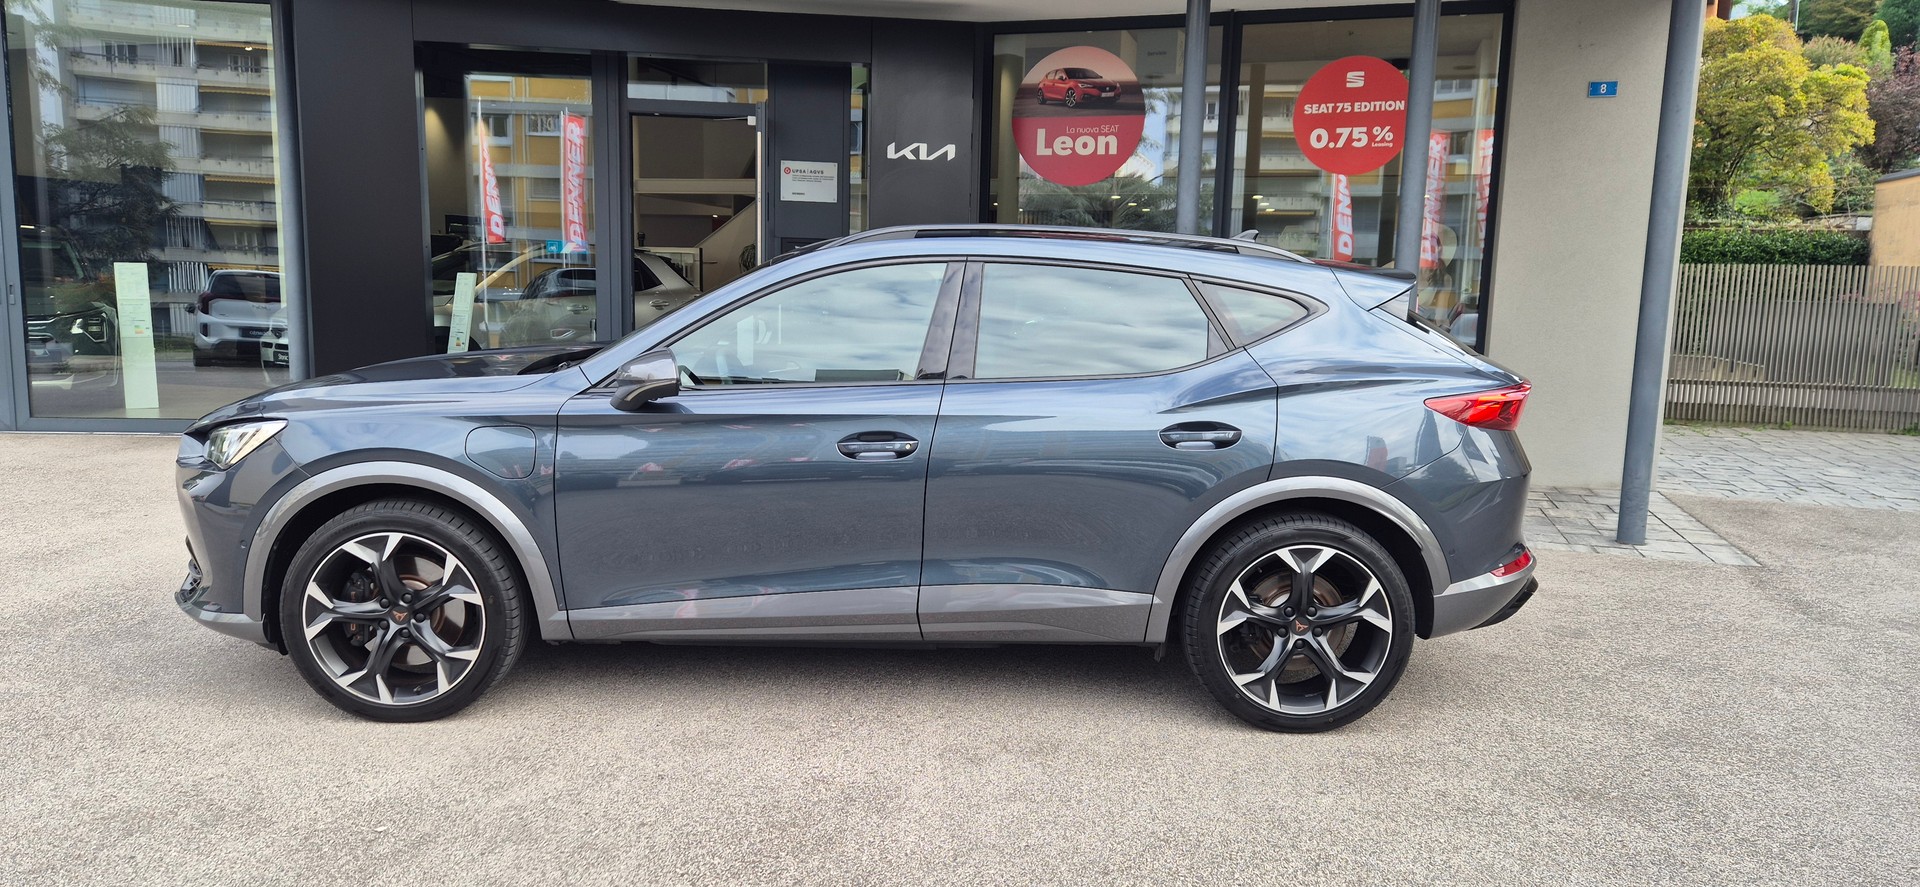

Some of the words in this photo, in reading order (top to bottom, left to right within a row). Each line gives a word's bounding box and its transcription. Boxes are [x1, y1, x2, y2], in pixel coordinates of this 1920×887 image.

[1600, 83, 1607, 94] 8
[1304, 103, 1334, 114] SEAT
[1336, 102, 1351, 113] 75
[1354, 100, 1405, 112] EDITION
[1066, 126, 1075, 134] La
[1101, 125, 1120, 133] SEAT
[1036, 128, 1118, 156] Leon
[1310, 126, 1368, 149] 0.75
